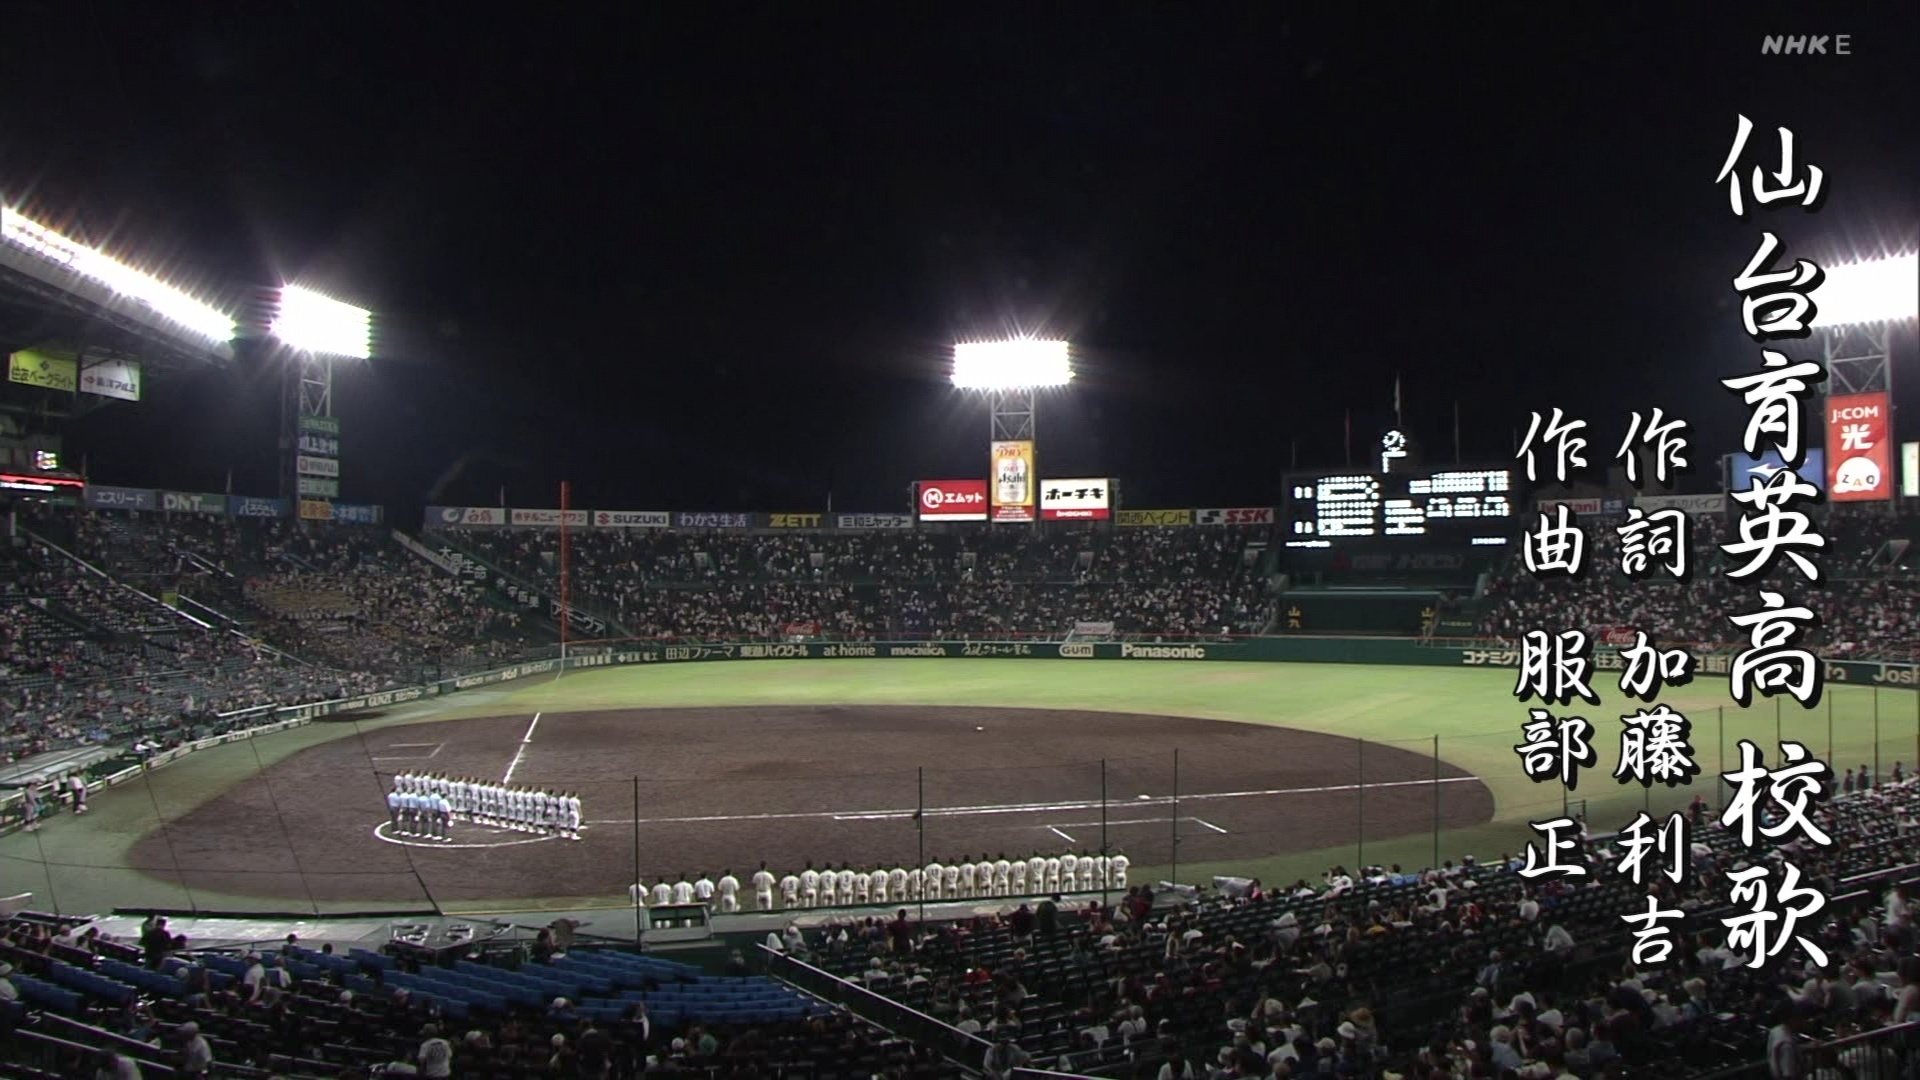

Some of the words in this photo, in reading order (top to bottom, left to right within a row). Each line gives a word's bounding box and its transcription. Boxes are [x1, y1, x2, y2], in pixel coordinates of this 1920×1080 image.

[1832, 405, 1878, 423] J:COM
[1841, 423, 1874, 450] 光
[95, 491, 147, 506] エスリード
[944, 493, 984, 504] エムット
[1045, 487, 1104, 500] ホーチキ
[163, 494, 203, 512] DNT
[613, 514, 667, 525] SUZUKI
[679, 513, 747, 527] わかさ生活
[769, 513, 821, 527] ZETT
[1118, 511, 1190, 524] 関西ペイント
[1224, 509, 1270, 523] SSK
[438, 545, 488, 580] 大同生命
[1287, 605, 1301, 629] 山九
[665, 646, 735, 660] 田辺ファーマ
[1121, 644, 1206, 659] Panasonic
